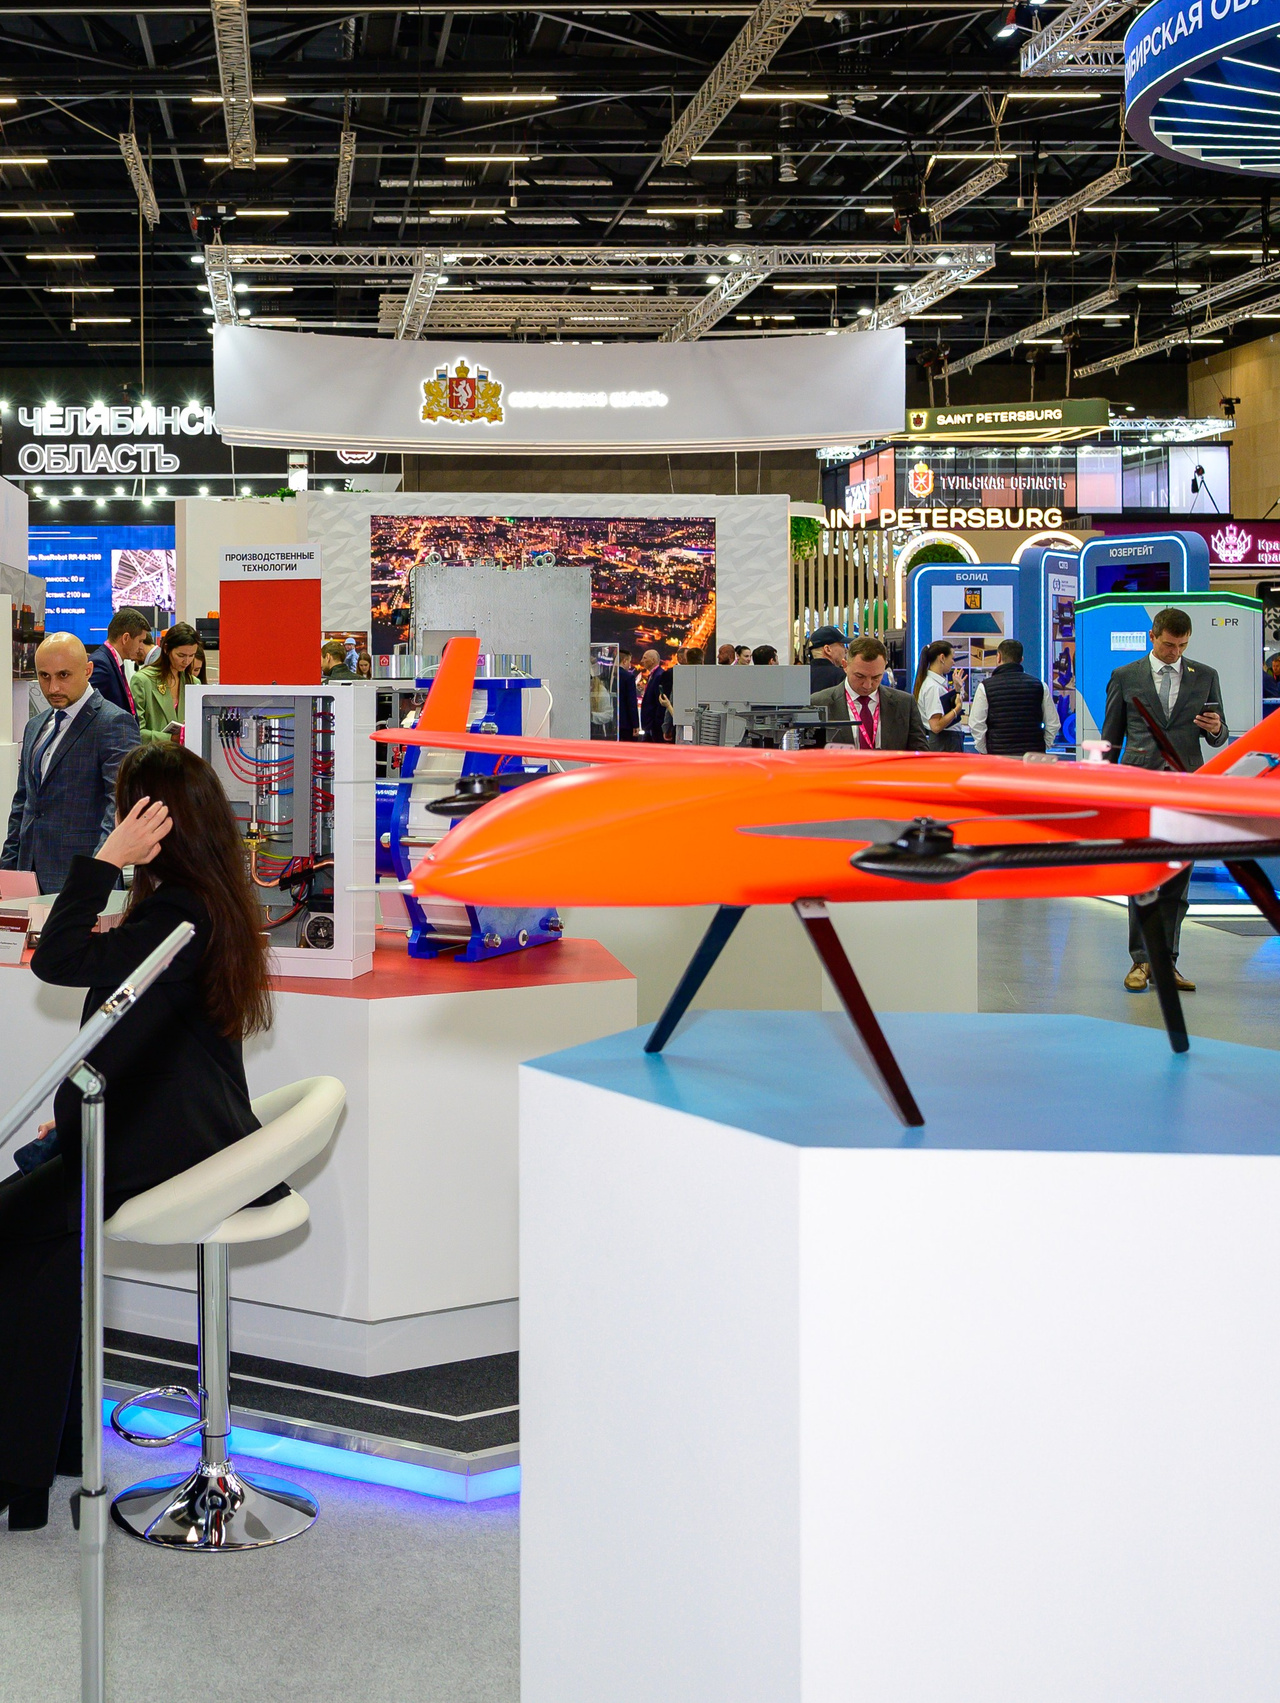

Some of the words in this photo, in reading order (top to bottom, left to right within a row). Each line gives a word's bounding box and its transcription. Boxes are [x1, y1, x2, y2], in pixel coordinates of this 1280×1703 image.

[936, 413, 973, 426] SAINT
[976, 409, 1063, 423] PETERSBURG
[18, 444, 180, 473] ОБЛАСТЬ
[940, 475, 1005, 490] ТУЛЬСКАЯ
[1010, 475, 1067, 490] ОБЛАСТЬ
[880, 508, 1063, 529] PETERSBURG
[225, 552, 315, 562] ПРОИЗВОДСТВЕННЫЕ
[1109, 545, 1154, 557] ЮЗЕРГЕЙТ
[1258, 553, 1280, 564] кра
[242, 563, 297, 572] ТЕХНОЛОГИИ
[955, 573, 988, 582] БОЛИД
